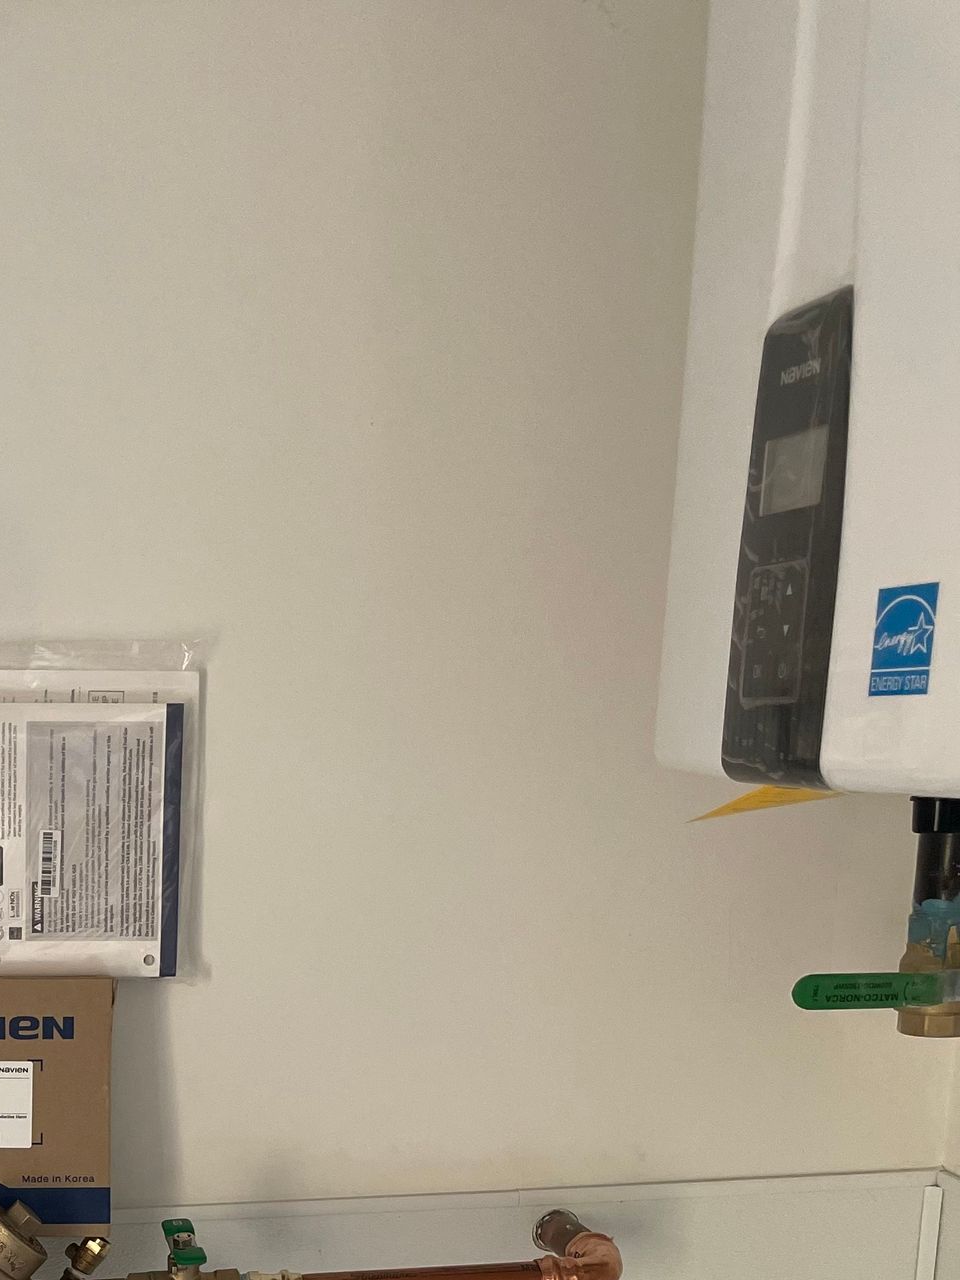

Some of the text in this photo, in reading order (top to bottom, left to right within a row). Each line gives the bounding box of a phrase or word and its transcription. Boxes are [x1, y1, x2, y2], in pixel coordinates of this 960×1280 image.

[871, 675, 927, 691] ENERGY STAR
[825, 992, 899, 1003] MATCO-NORCA
[22, 1175, 95, 1183] Made in Korea
